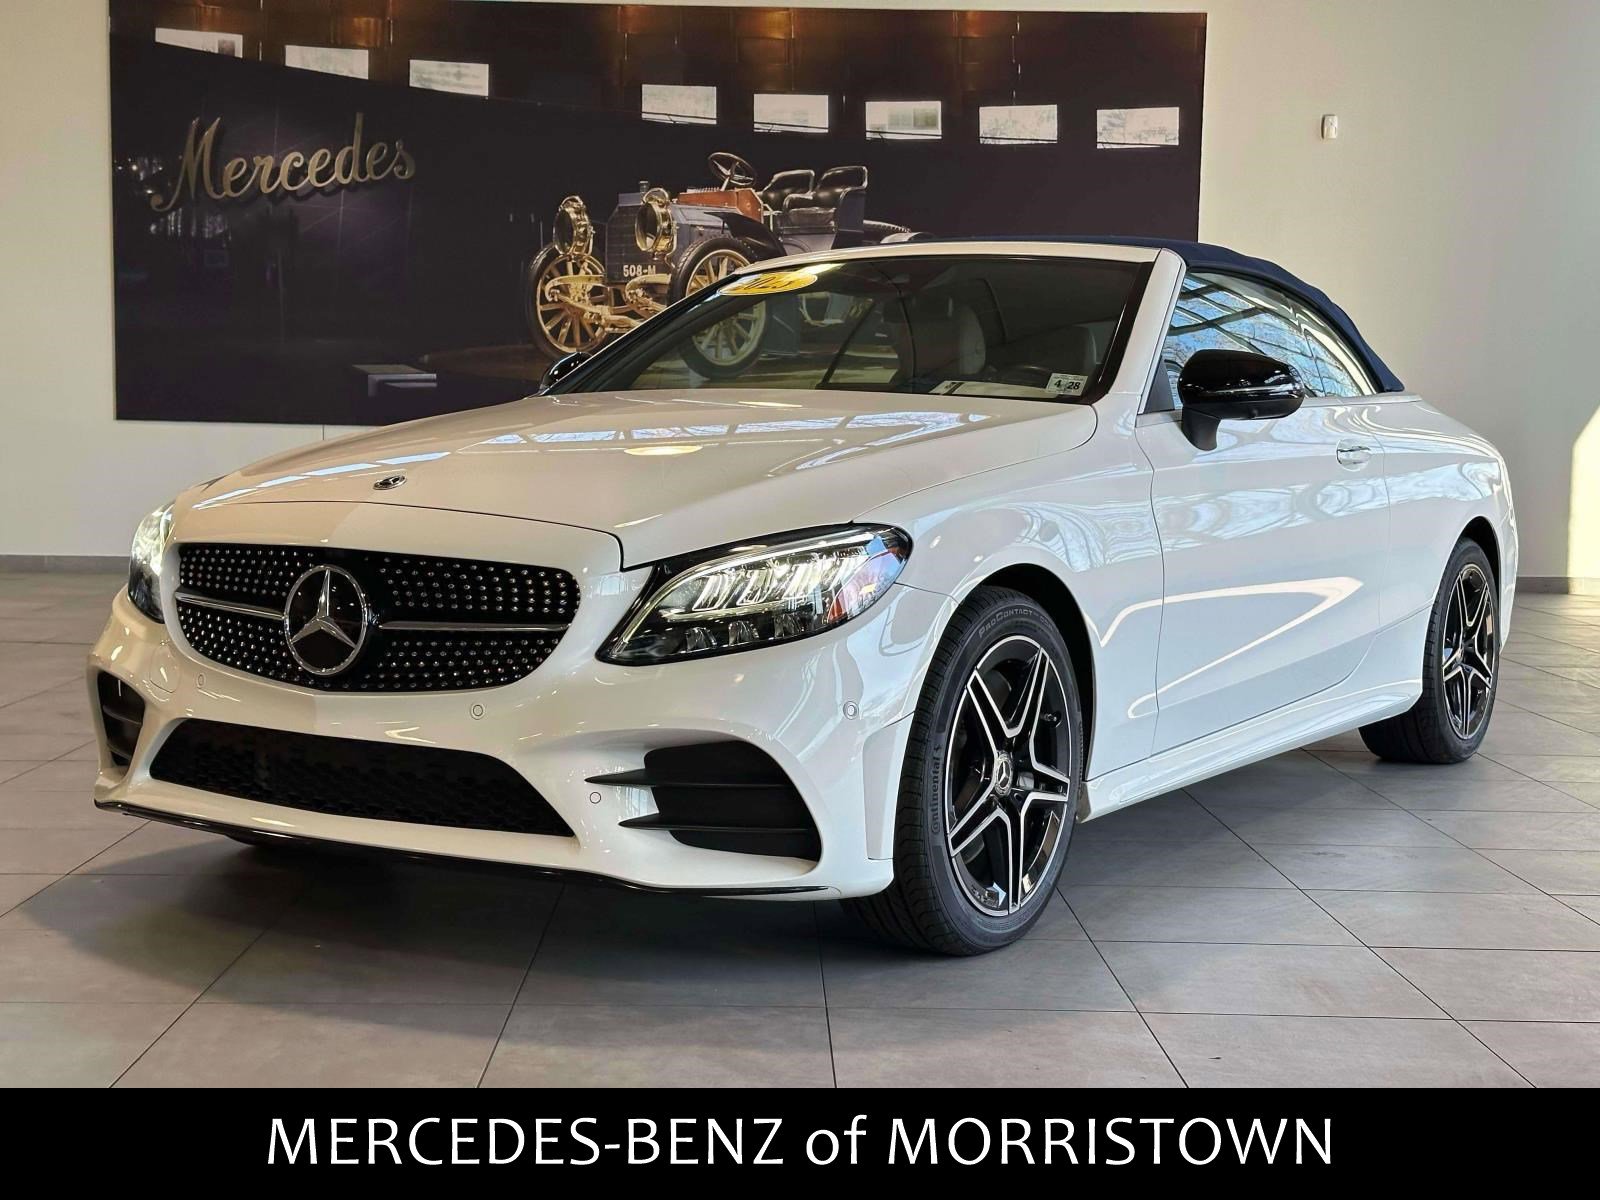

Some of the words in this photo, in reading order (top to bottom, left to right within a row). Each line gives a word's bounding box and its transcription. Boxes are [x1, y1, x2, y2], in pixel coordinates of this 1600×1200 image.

[151, 112, 416, 212] Mercedes
[1053, 379, 1062, 388] 4
[1066, 381, 1081, 390] 28
[930, 756, 943, 835] Continental
